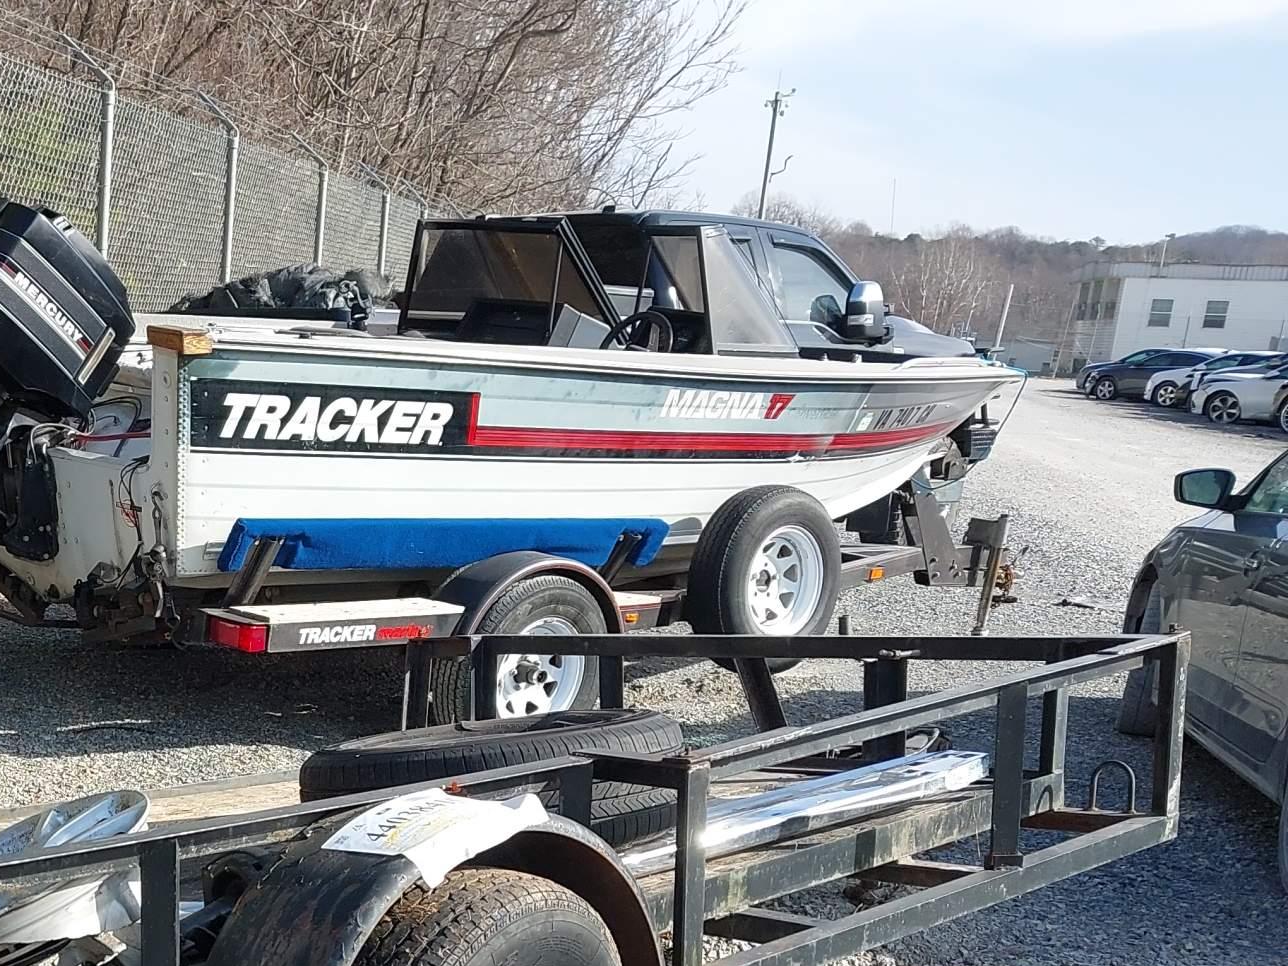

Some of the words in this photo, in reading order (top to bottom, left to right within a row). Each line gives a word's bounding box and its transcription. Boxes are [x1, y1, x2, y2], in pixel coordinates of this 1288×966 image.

[13, 271, 83, 342] MERCURY
[219, 392, 454, 445] TRACKER
[660, 388, 765, 420] MAGNA
[298, 624, 377, 645] TRACKER
[366, 798, 456, 842] 4403841
